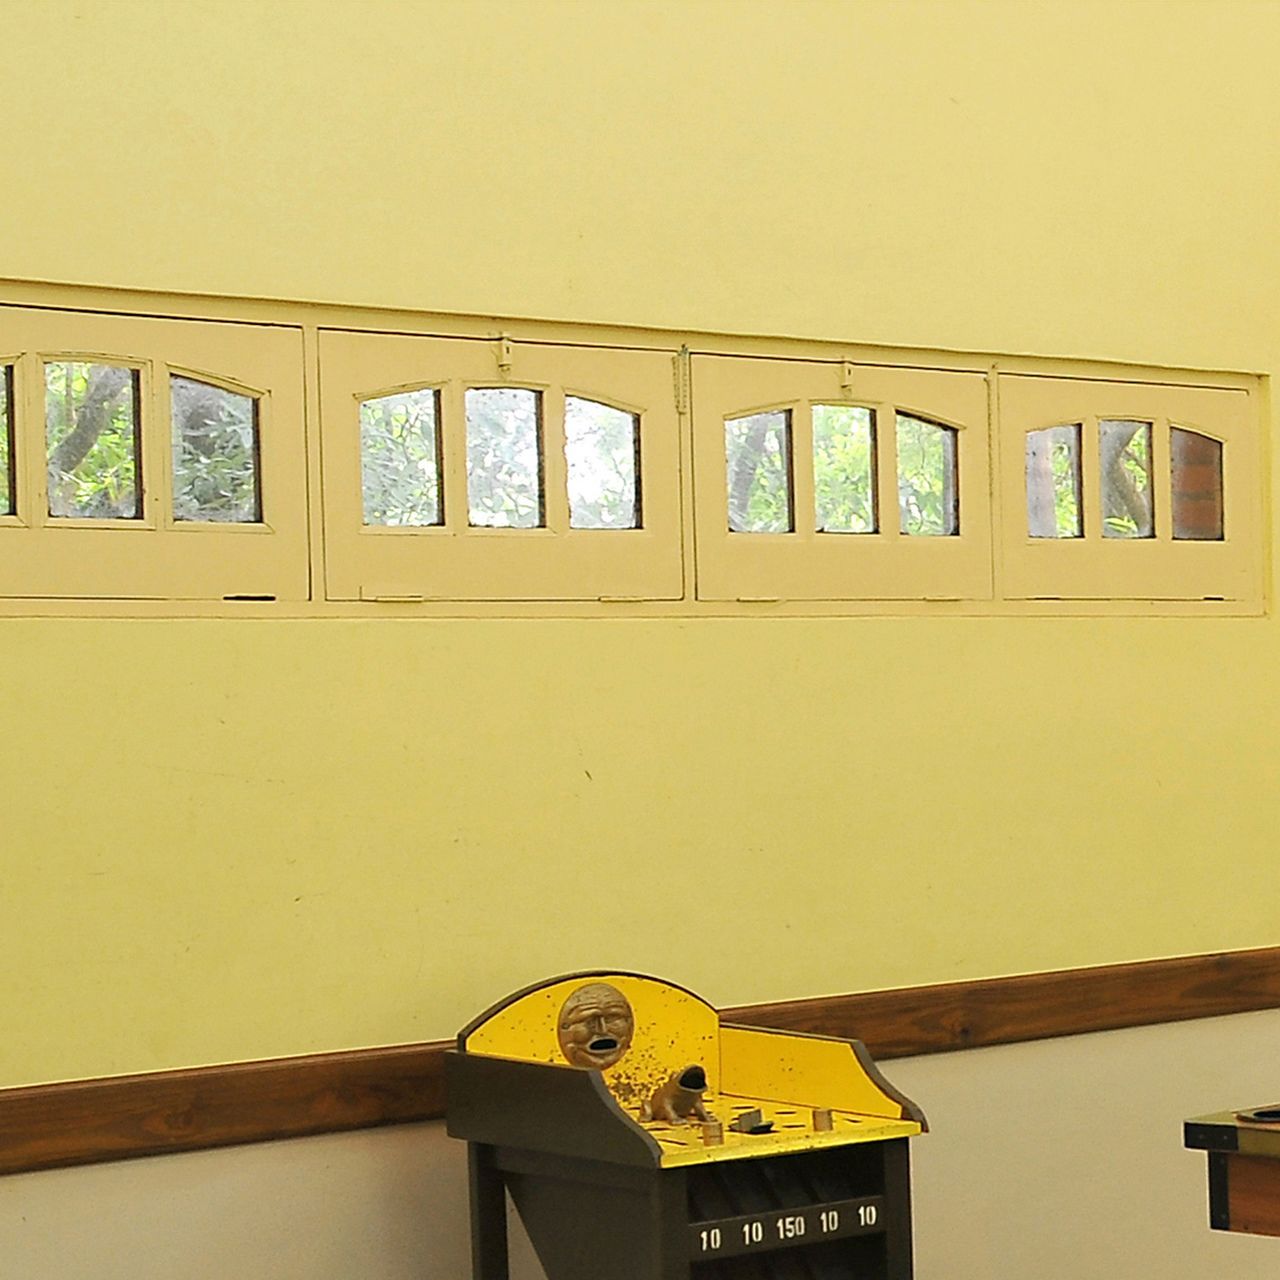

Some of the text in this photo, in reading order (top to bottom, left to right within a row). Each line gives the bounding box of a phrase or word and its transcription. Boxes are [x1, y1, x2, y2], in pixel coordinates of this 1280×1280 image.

[701, 1206, 877, 1251] 10 10 150 10 10
